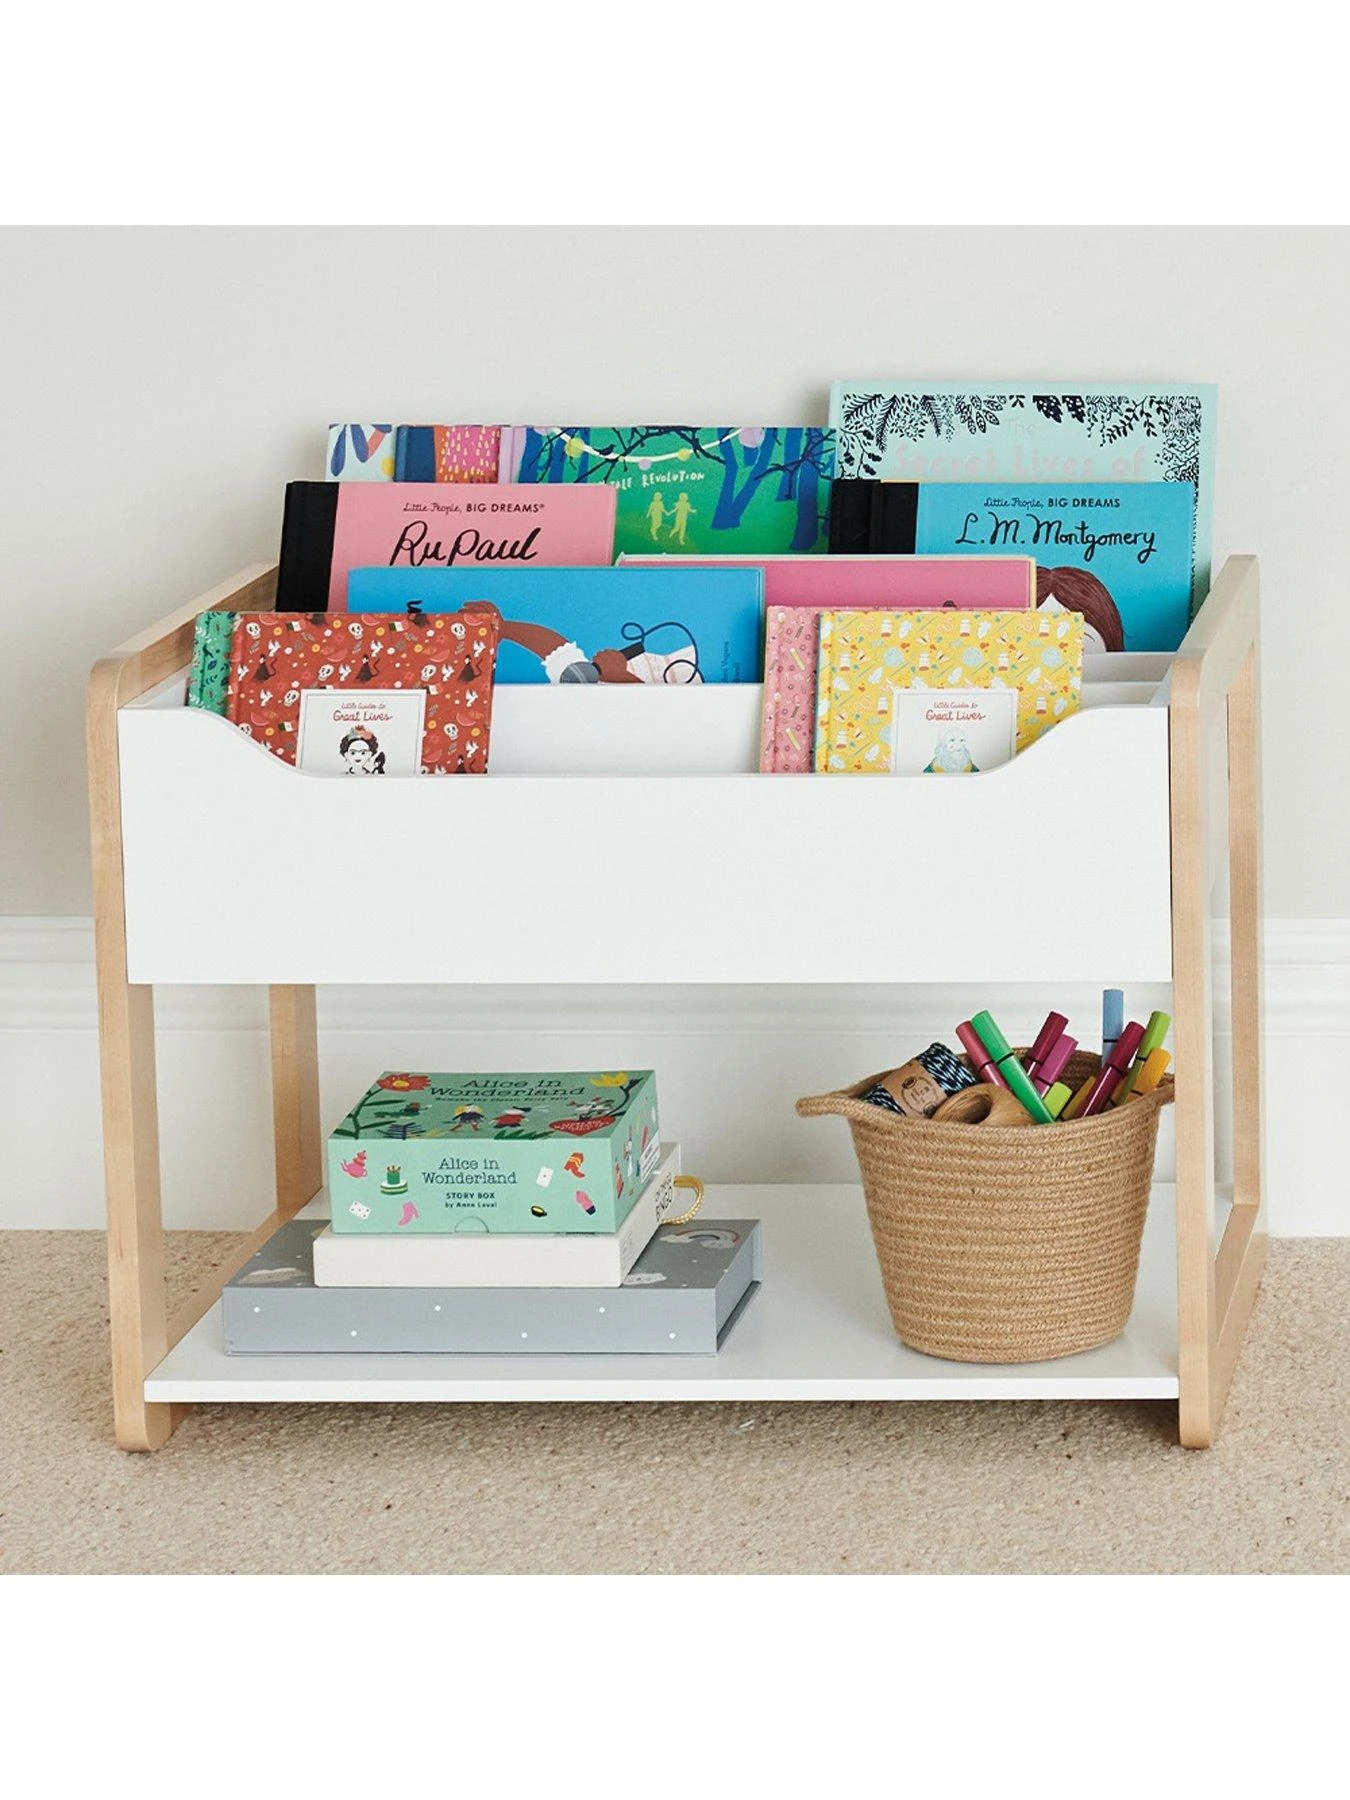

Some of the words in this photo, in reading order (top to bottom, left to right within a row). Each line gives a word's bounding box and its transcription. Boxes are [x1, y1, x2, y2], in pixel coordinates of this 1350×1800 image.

[642, 470, 705, 488] REVOLUTION
[403, 502, 428, 512] Little
[430, 502, 462, 515] People,
[466, 503, 486, 513] BIG
[984, 497, 1010, 508] Little
[1048, 498, 1068, 508] BIG
[1072, 498, 1120, 508] DREAMS
[1026, 513, 1157, 564] Montgomery
[333, 709, 361, 721] Great
[363, 711, 393, 721] Lives
[926, 709, 953, 721] Great
[956, 710, 986, 721] Lives
[463, 1079, 529, 1088] Alice
[536, 1078, 562, 1087] in
[430, 1086, 585, 1097] Wonderland
[438, 1158, 479, 1170] Alice
[483, 1158, 500, 1170] in
[421, 1171, 518, 1184] Wonderland
[446, 1192, 475, 1200] STORY
[477, 1192, 496, 1200] BOX
